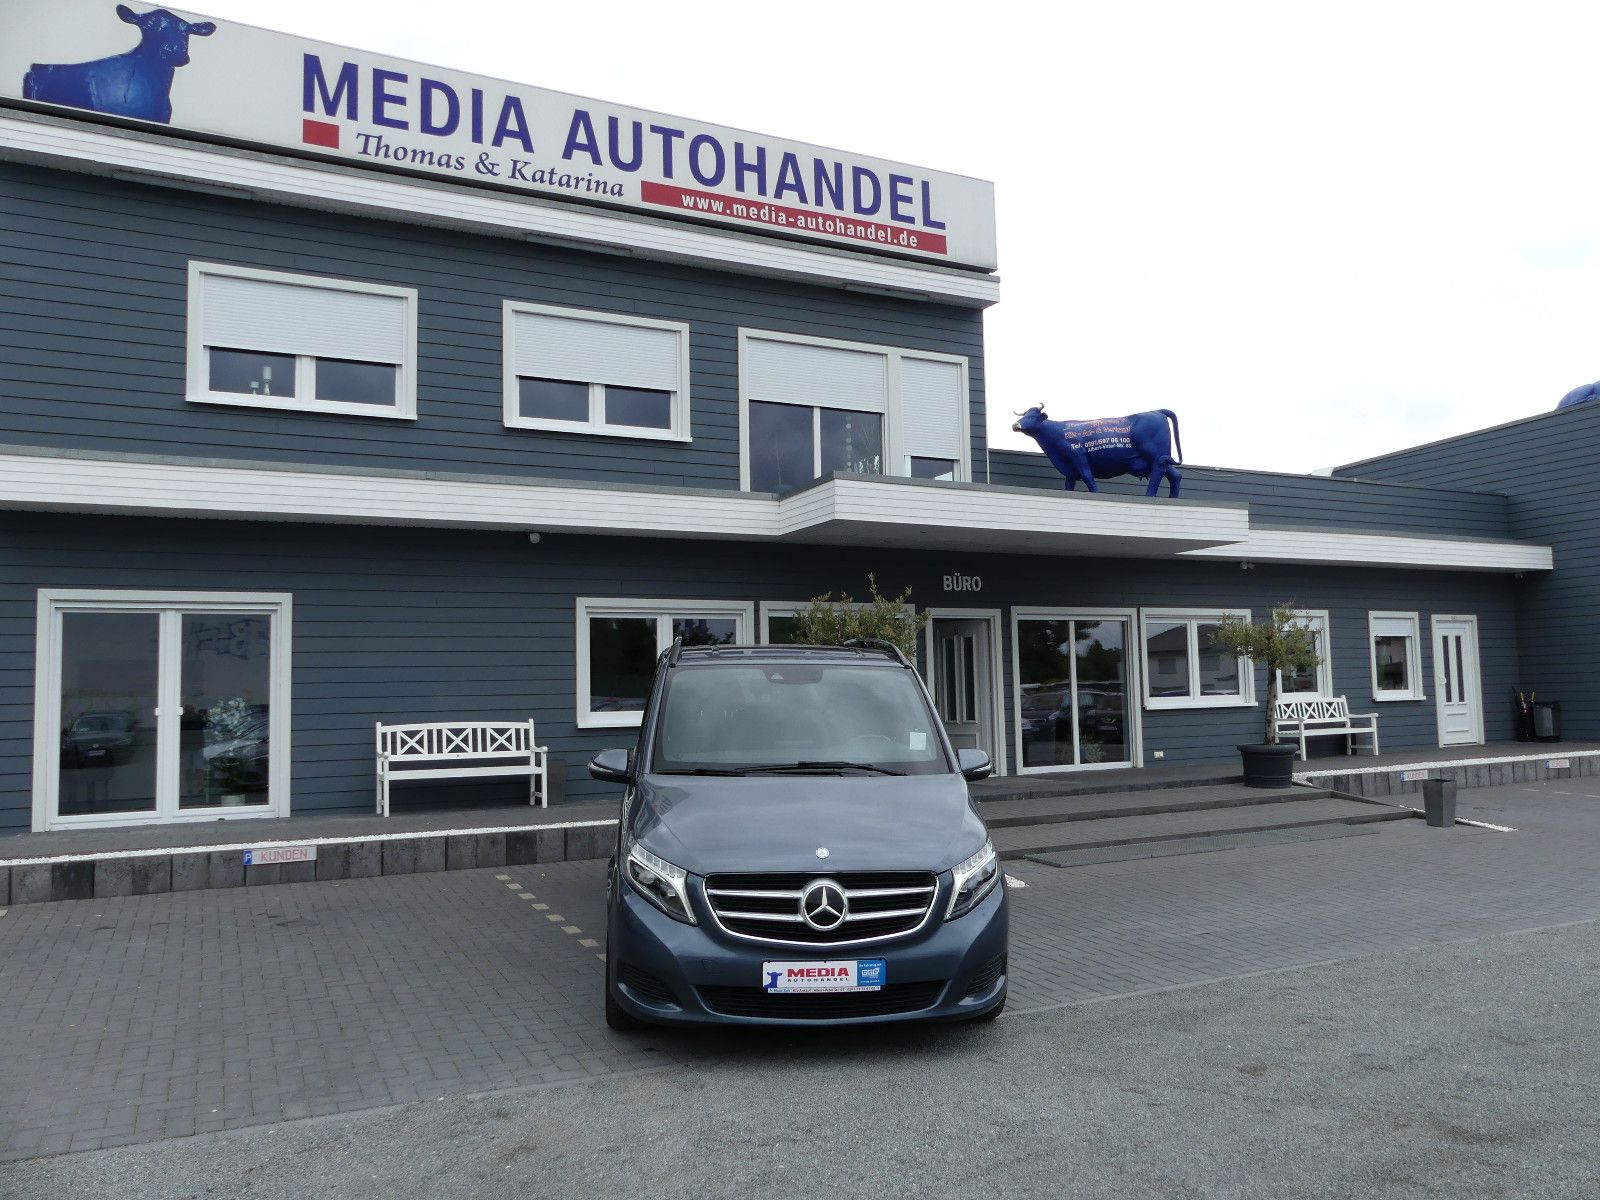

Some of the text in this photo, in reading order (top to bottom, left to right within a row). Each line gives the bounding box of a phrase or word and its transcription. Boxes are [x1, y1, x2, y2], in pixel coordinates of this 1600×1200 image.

[303, 53, 946, 230] MEDIA AUTOHANDEL
[356, 132, 625, 197] Thomas & Katarina
[681, 192, 918, 247] www.media-autohandel.de
[943, 572, 982, 592] BÜRO
[260, 848, 308, 862] KUNDEN
[787, 968, 849, 978] MEDIA
